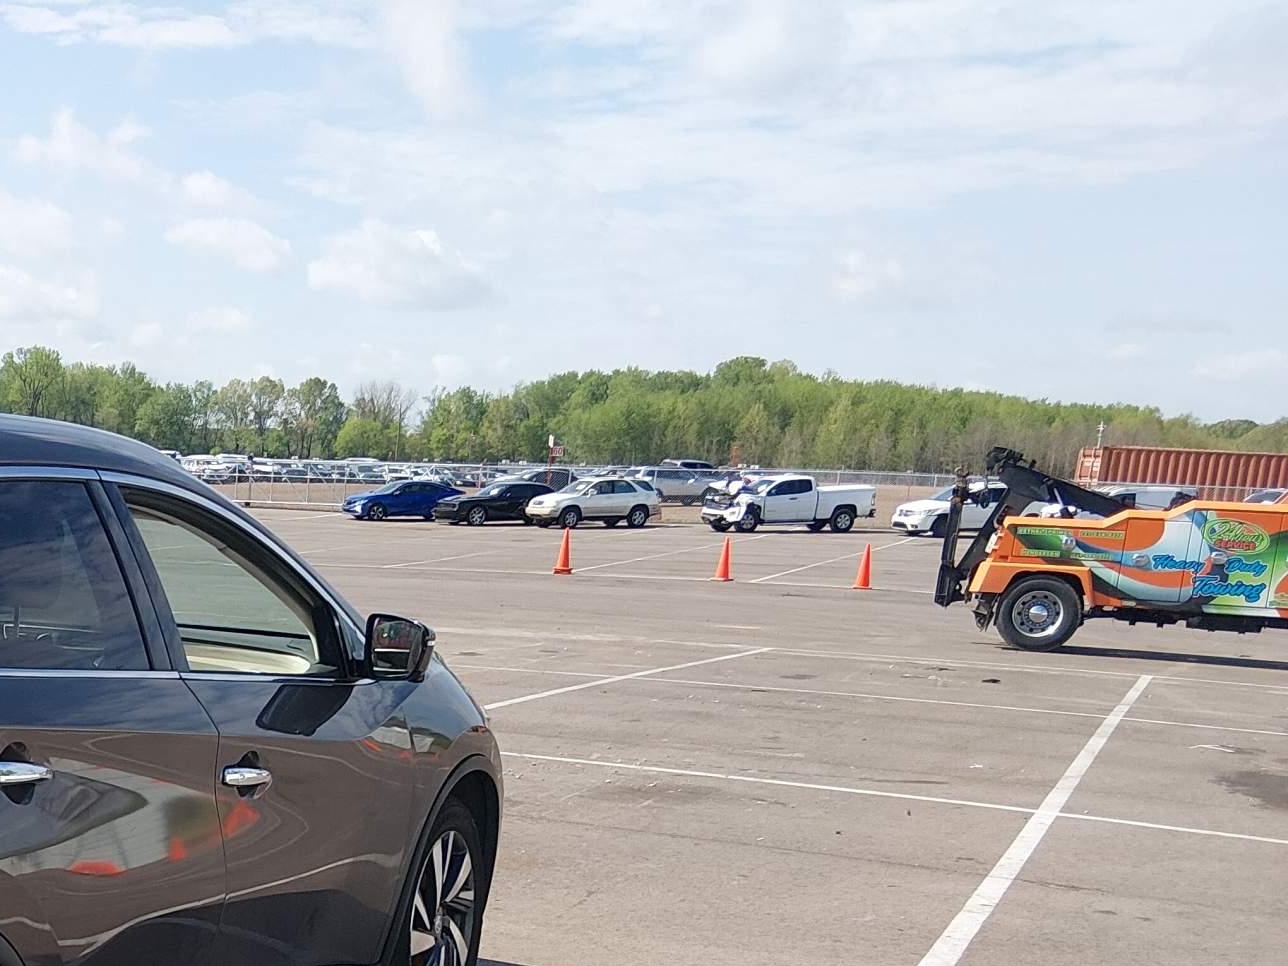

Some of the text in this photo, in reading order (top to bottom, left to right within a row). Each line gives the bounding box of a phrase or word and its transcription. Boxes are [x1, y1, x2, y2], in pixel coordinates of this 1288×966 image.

[1214, 539, 1257, 551] SERVICE
[1152, 555, 1268, 577] Heavy Duty
[1193, 576, 1266, 603] Towing
